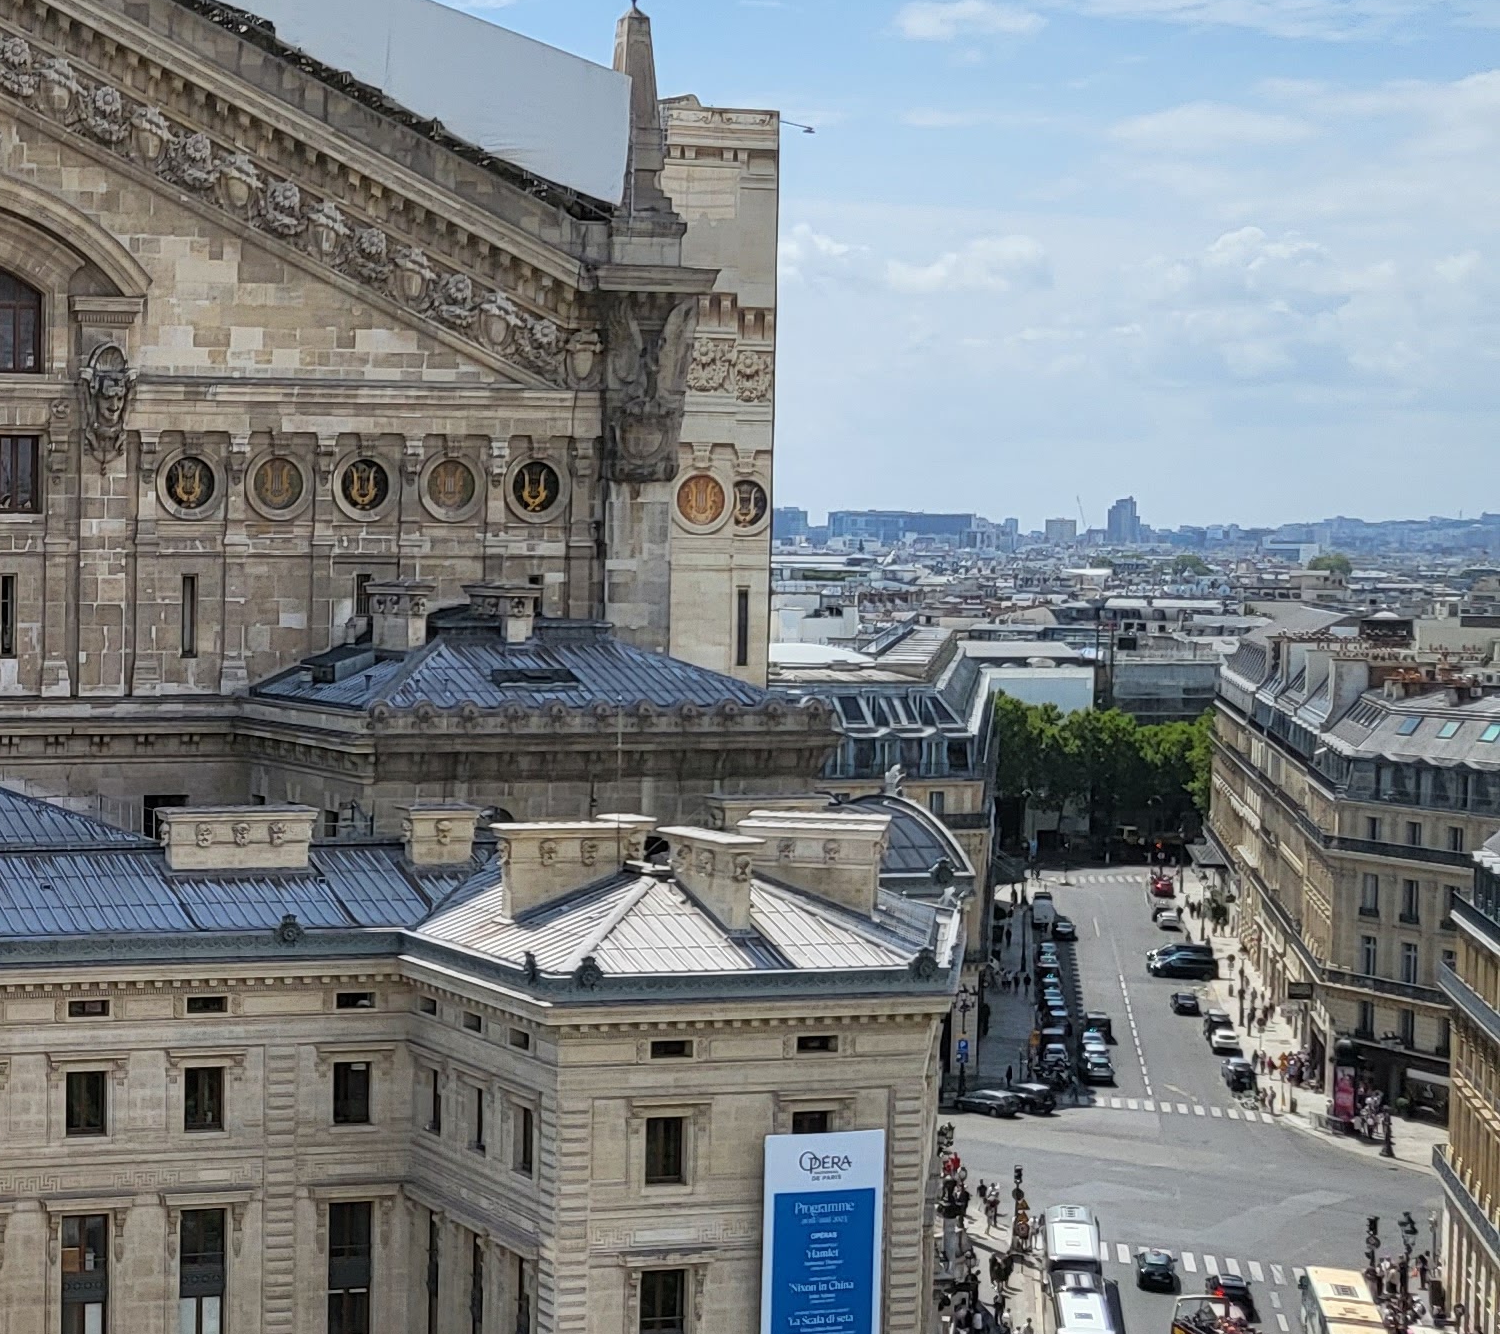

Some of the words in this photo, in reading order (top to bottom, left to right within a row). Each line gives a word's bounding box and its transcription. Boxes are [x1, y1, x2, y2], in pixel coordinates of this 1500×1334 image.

[799, 1151, 852, 1175] OPÉRA
[795, 1202, 855, 1217] Programme
[818, 1282, 827, 1291] in
[828, 1280, 855, 1291] China
